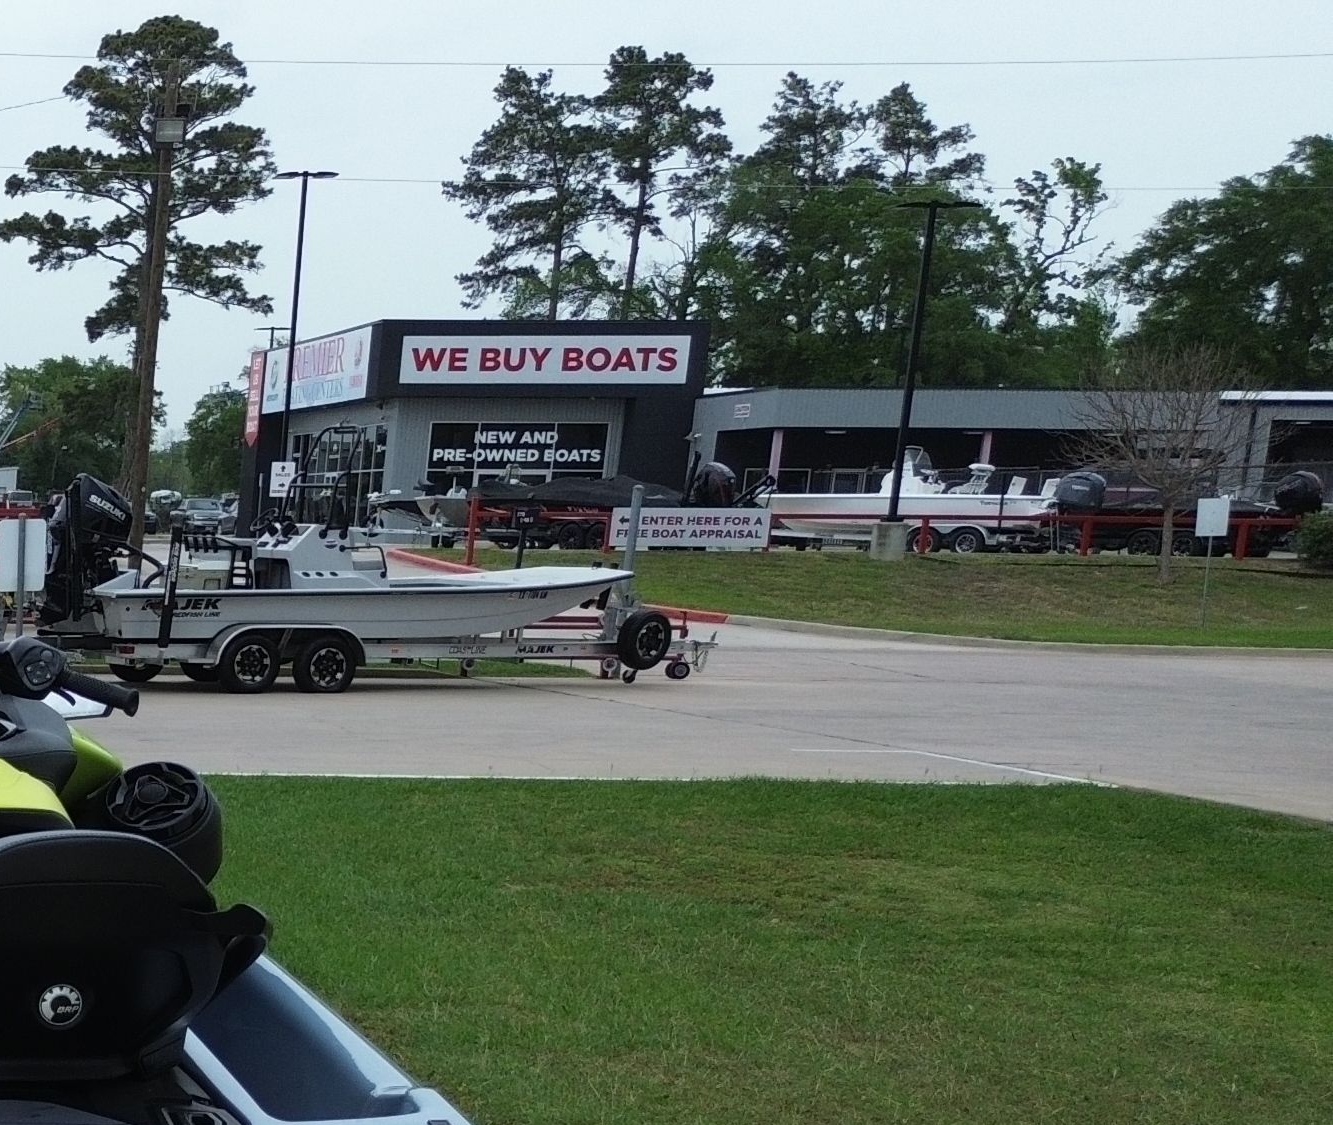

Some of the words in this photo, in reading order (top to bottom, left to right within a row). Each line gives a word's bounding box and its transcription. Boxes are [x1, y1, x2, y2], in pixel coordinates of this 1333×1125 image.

[292, 337, 345, 382] REMIER
[411, 347, 469, 372] WE
[478, 347, 553, 372] BUY
[561, 347, 678, 372] BOATS
[474, 431, 517, 444] NEW
[519, 431, 559, 444] AND
[433, 449, 539, 463] PRE-OWNED
[543, 449, 601, 462] BOATS
[88, 494, 127, 521] SUZUKI
[641, 516, 684, 526] ENTER
[686, 516, 721, 526] HERE
[724, 516, 751, 526] FOR
[753, 517, 764, 526] A
[651, 529, 687, 538] BOAT
[688, 529, 763, 539] APPRAISAL
[56, 1004, 81, 1014] BRP
